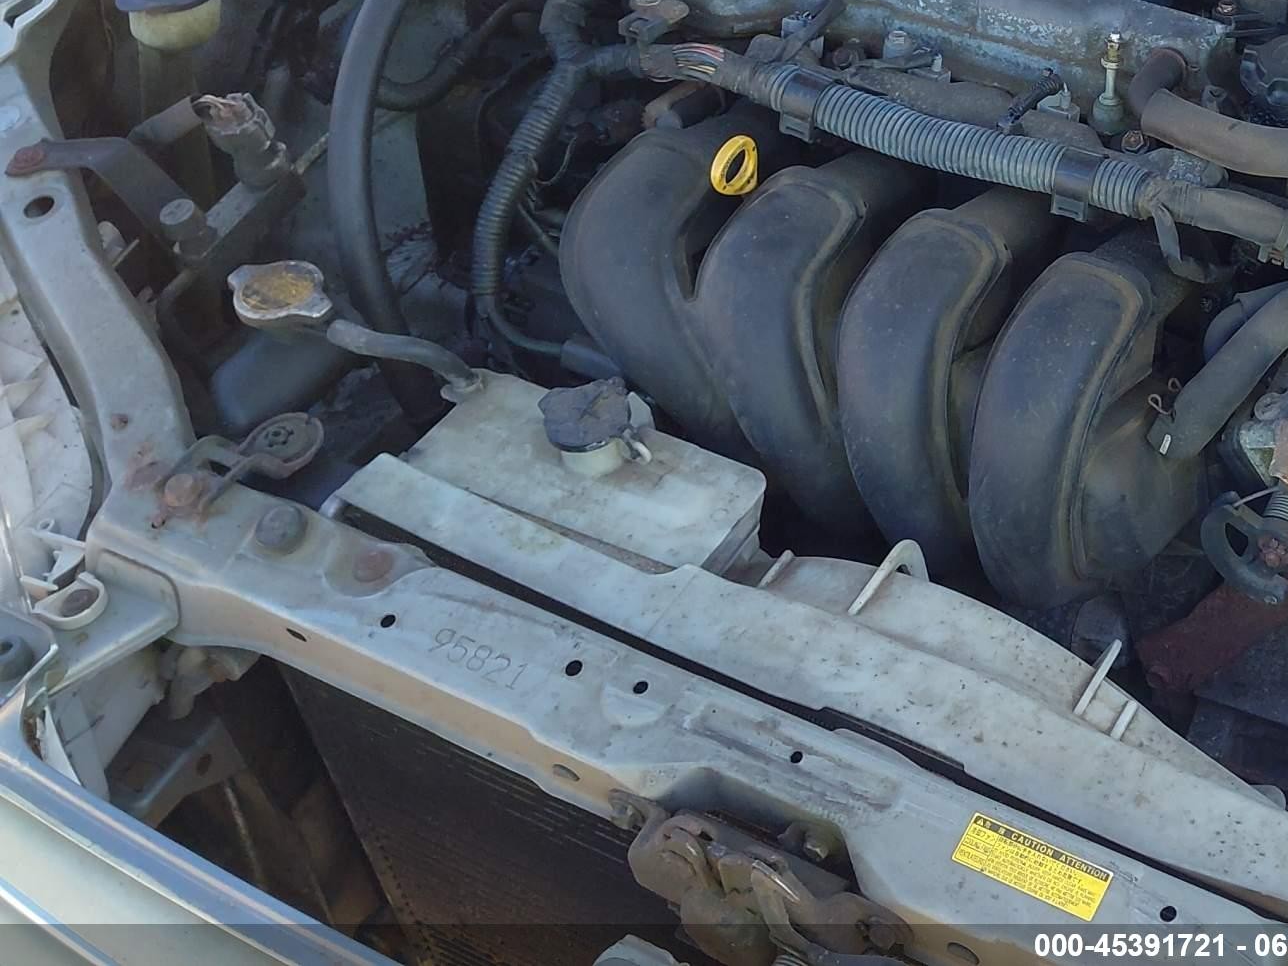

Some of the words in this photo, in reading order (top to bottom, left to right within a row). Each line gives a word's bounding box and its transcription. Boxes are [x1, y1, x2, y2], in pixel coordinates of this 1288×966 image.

[427, 627, 529, 691] 95821
[1011, 832, 1055, 857] CAUTION
[1059, 854, 1108, 881] ATTENTION
